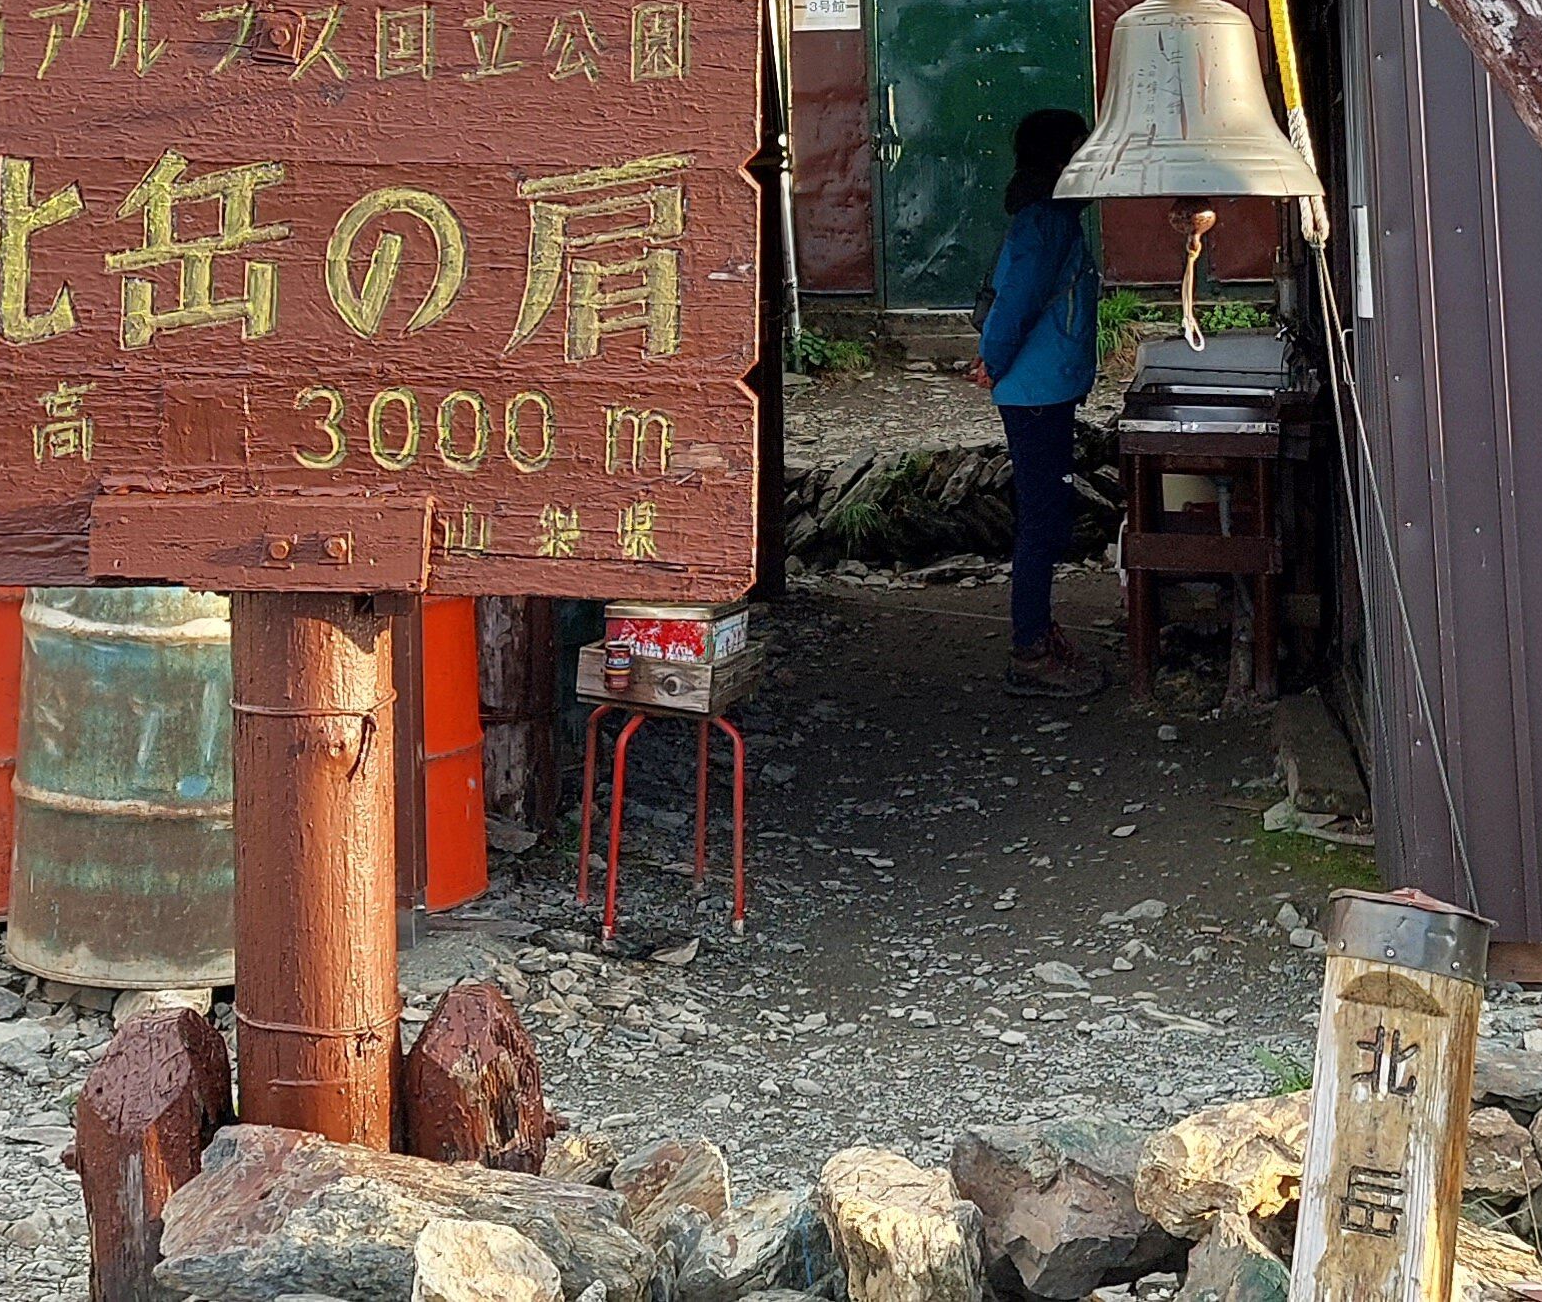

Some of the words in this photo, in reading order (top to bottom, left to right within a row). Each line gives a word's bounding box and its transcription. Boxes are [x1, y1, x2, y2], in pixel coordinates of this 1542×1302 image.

[292, 383, 557, 474] 3000
[604, 401, 675, 475] m
[441, 499, 658, 559] 山梨県
